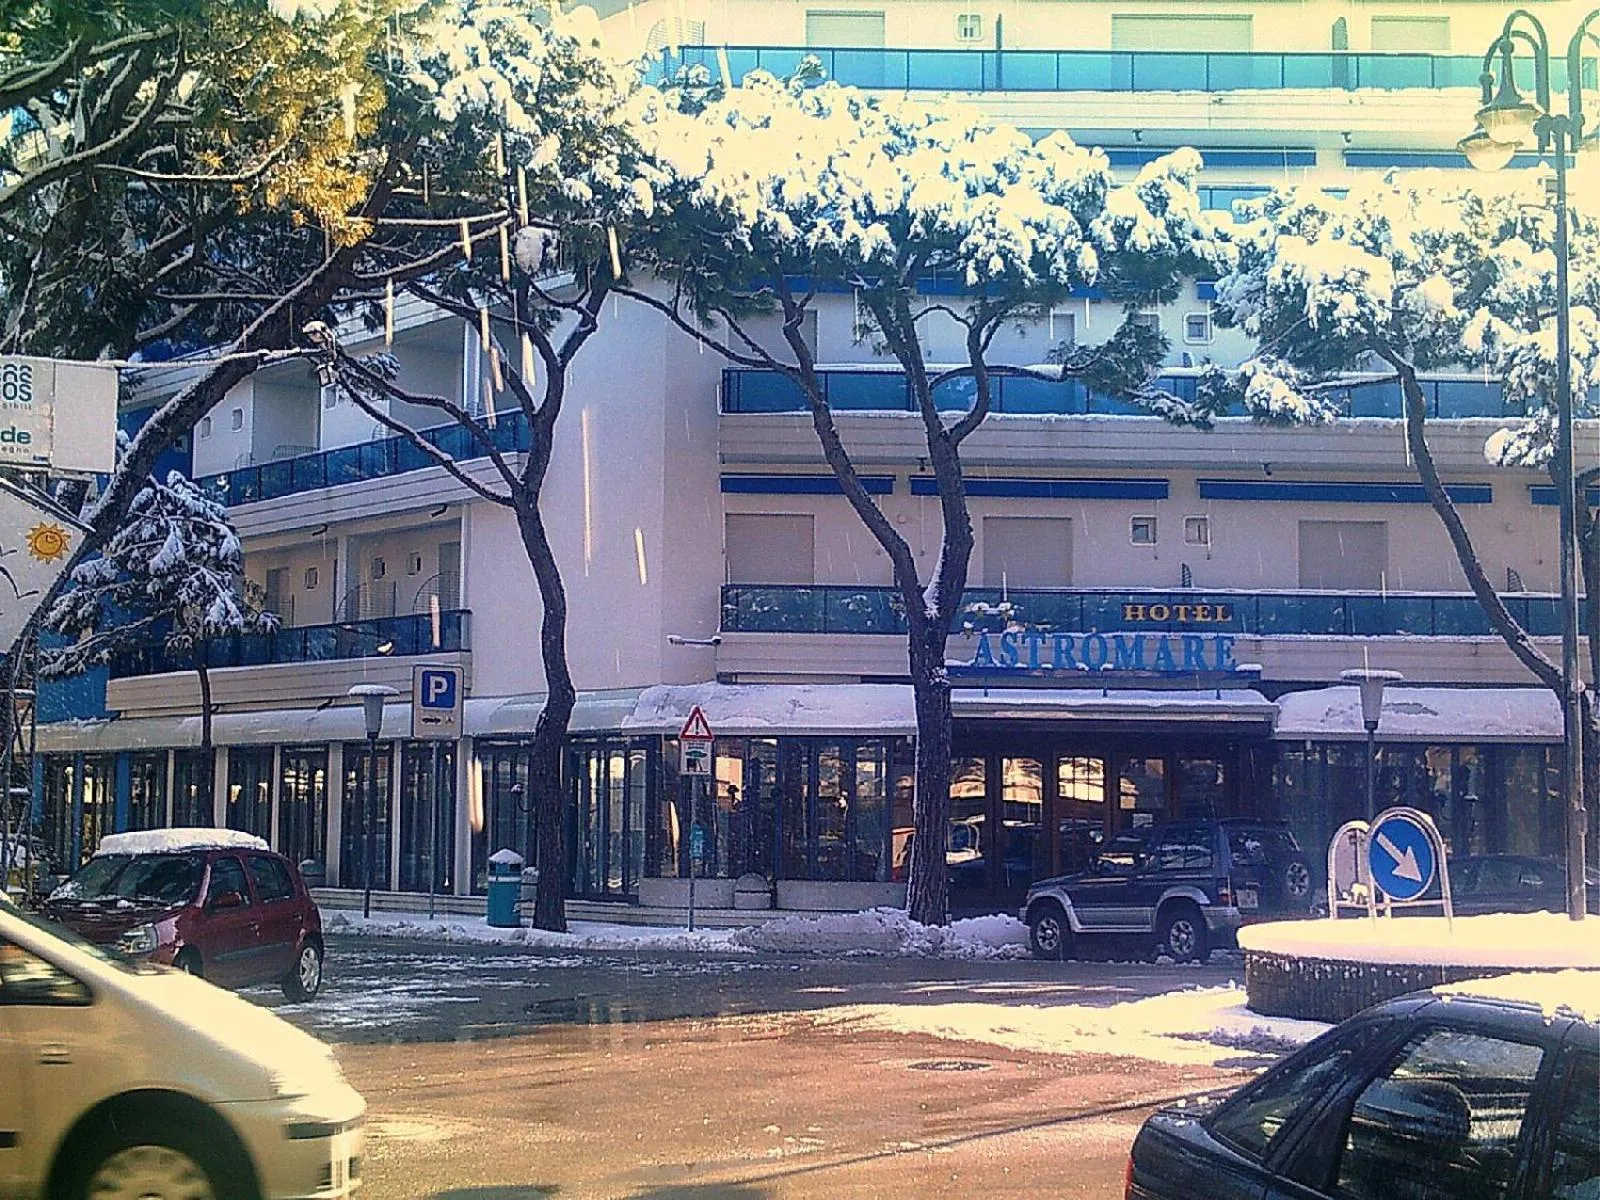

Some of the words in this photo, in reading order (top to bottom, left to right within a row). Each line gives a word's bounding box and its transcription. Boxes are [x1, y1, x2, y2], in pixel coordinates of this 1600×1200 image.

[1124, 604, 1233, 622] HOTEL
[975, 631, 1236, 671] ASTROMARE
[429, 675, 448, 703] P
